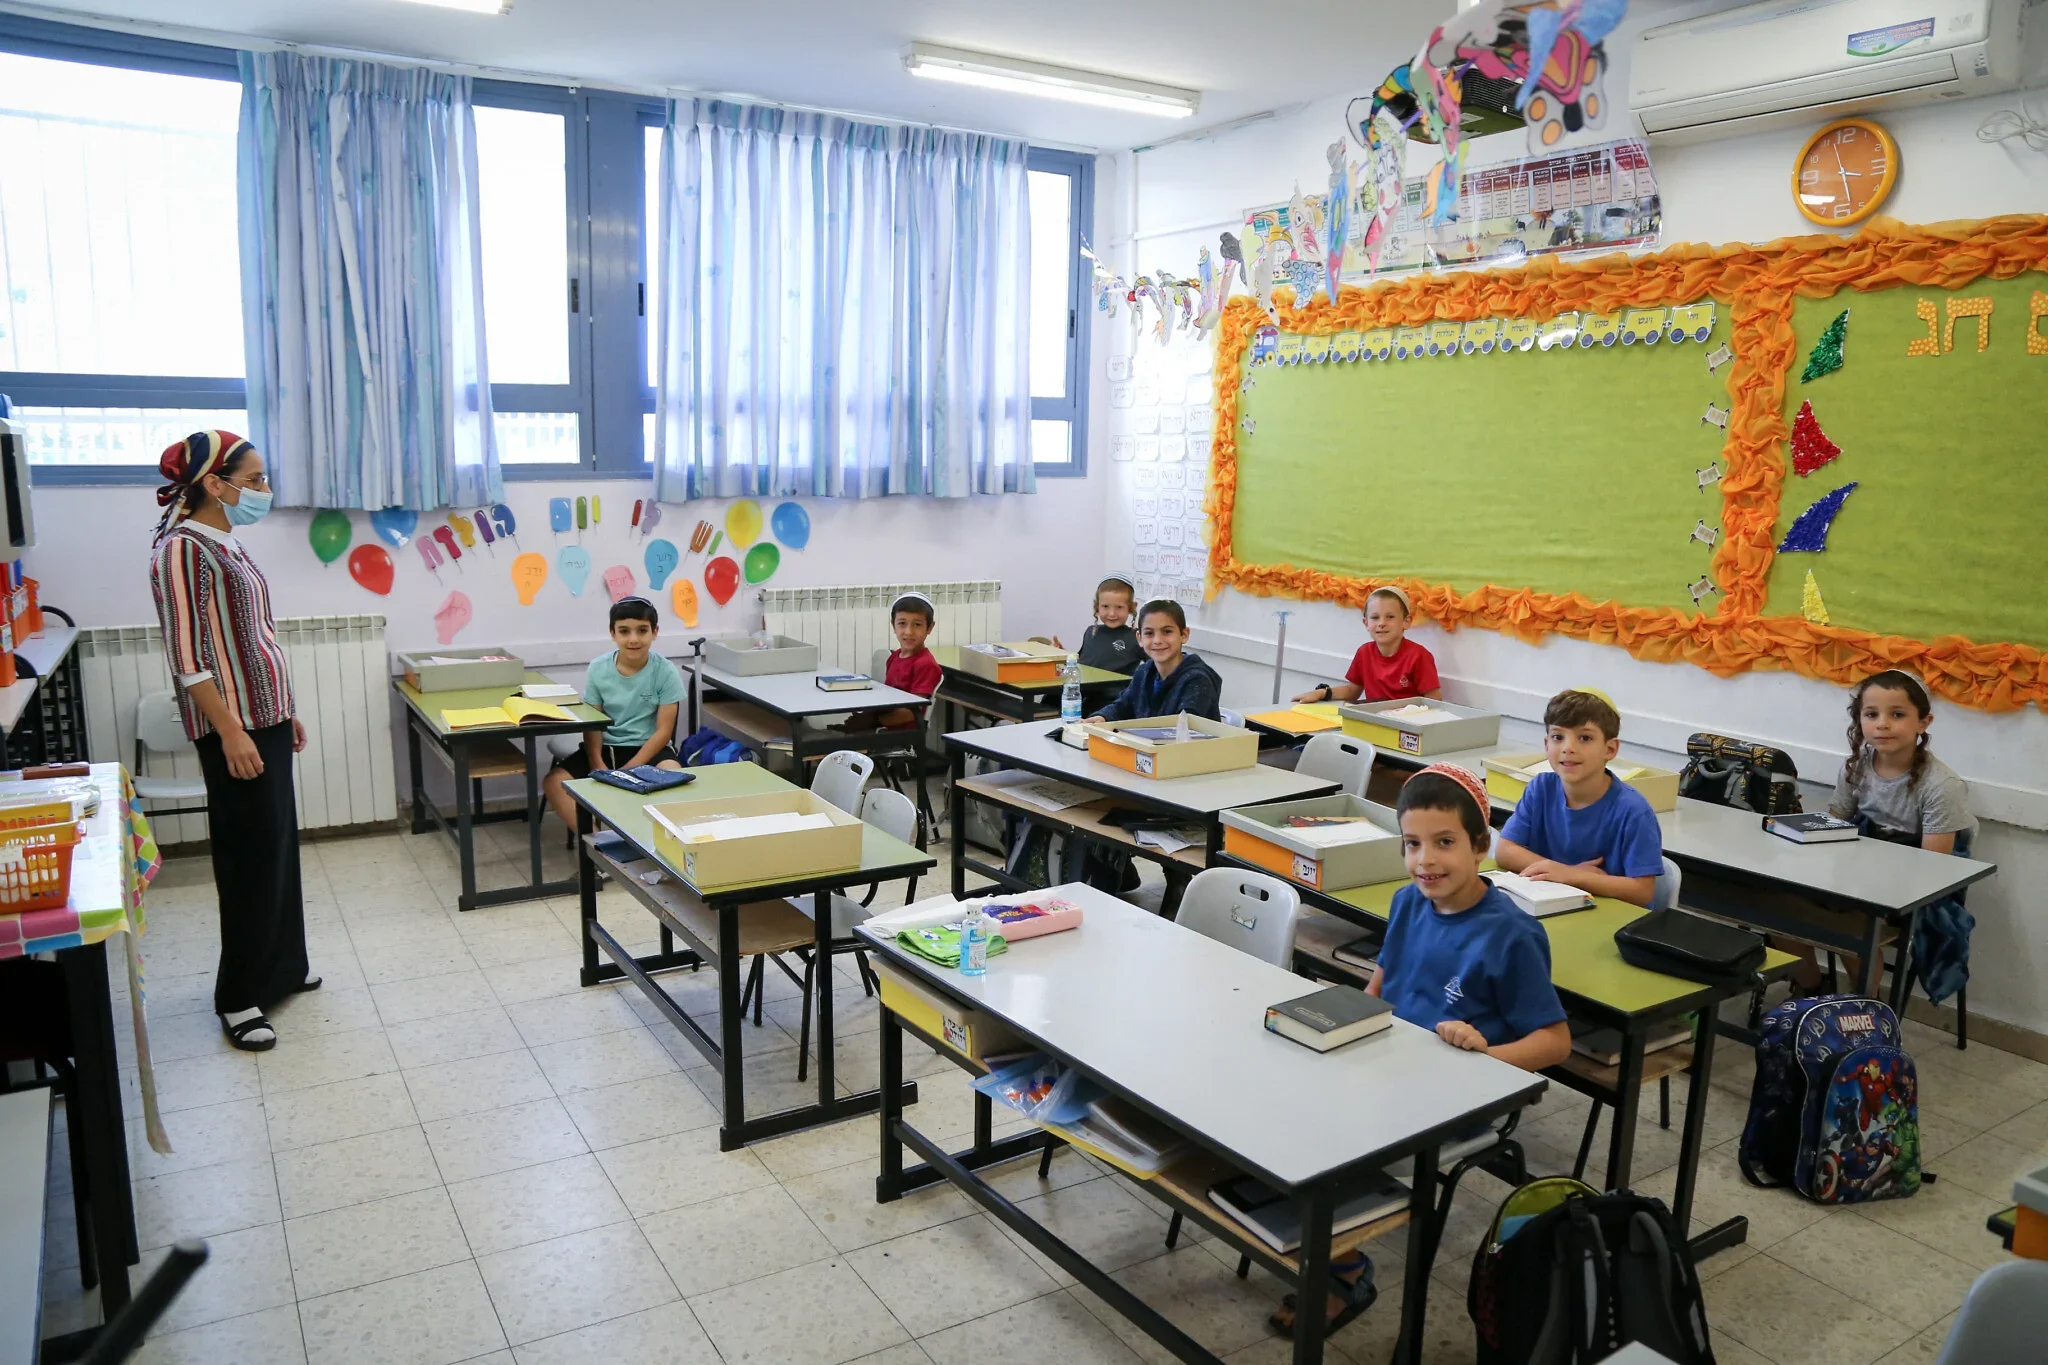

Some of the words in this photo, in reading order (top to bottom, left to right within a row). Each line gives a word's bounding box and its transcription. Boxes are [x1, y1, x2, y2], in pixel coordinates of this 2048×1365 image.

[1836, 127, 1857, 144] 12
[1874, 144, 1882, 152] 2
[1810, 155, 1819, 164] 10
[1870, 158, 1887, 176] 3
[1802, 169, 1819, 186] 9
[1821, 207, 1827, 215] 7
[1833, 202, 1851, 219] 6
[1906, 296, 1995, 358] חג
[1839, 1014, 1875, 1032] MARVEL
